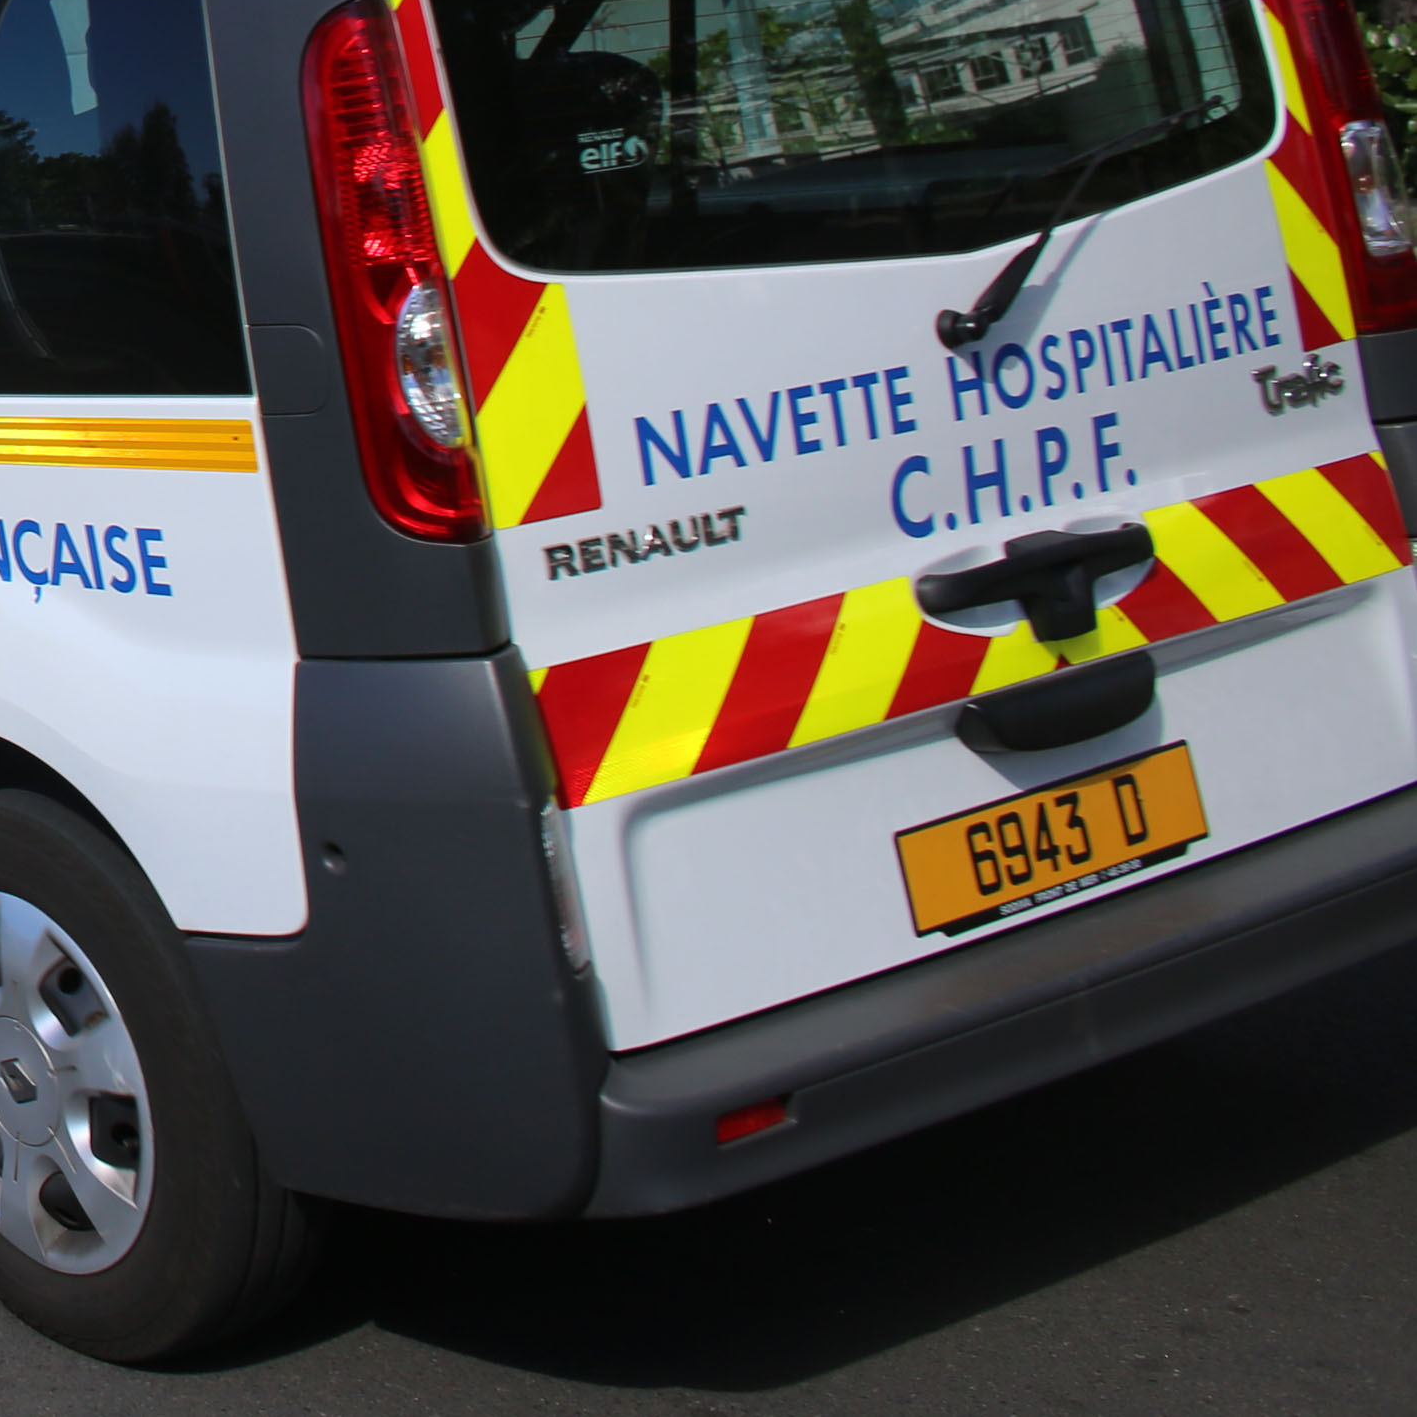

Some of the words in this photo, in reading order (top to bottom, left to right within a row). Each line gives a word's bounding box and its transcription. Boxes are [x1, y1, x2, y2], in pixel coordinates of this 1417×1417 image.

[580, 142, 623, 170] elf
[634, 365, 918, 486] NAVETTE
[945, 282, 1281, 422] HOSPITALIÈRE
[891, 412, 1139, 539] C.H.P.F.
[542, 506, 747, 580] RENAULT
[966, 790, 1092, 897] 6943
[1111, 773, 1148, 847] D
